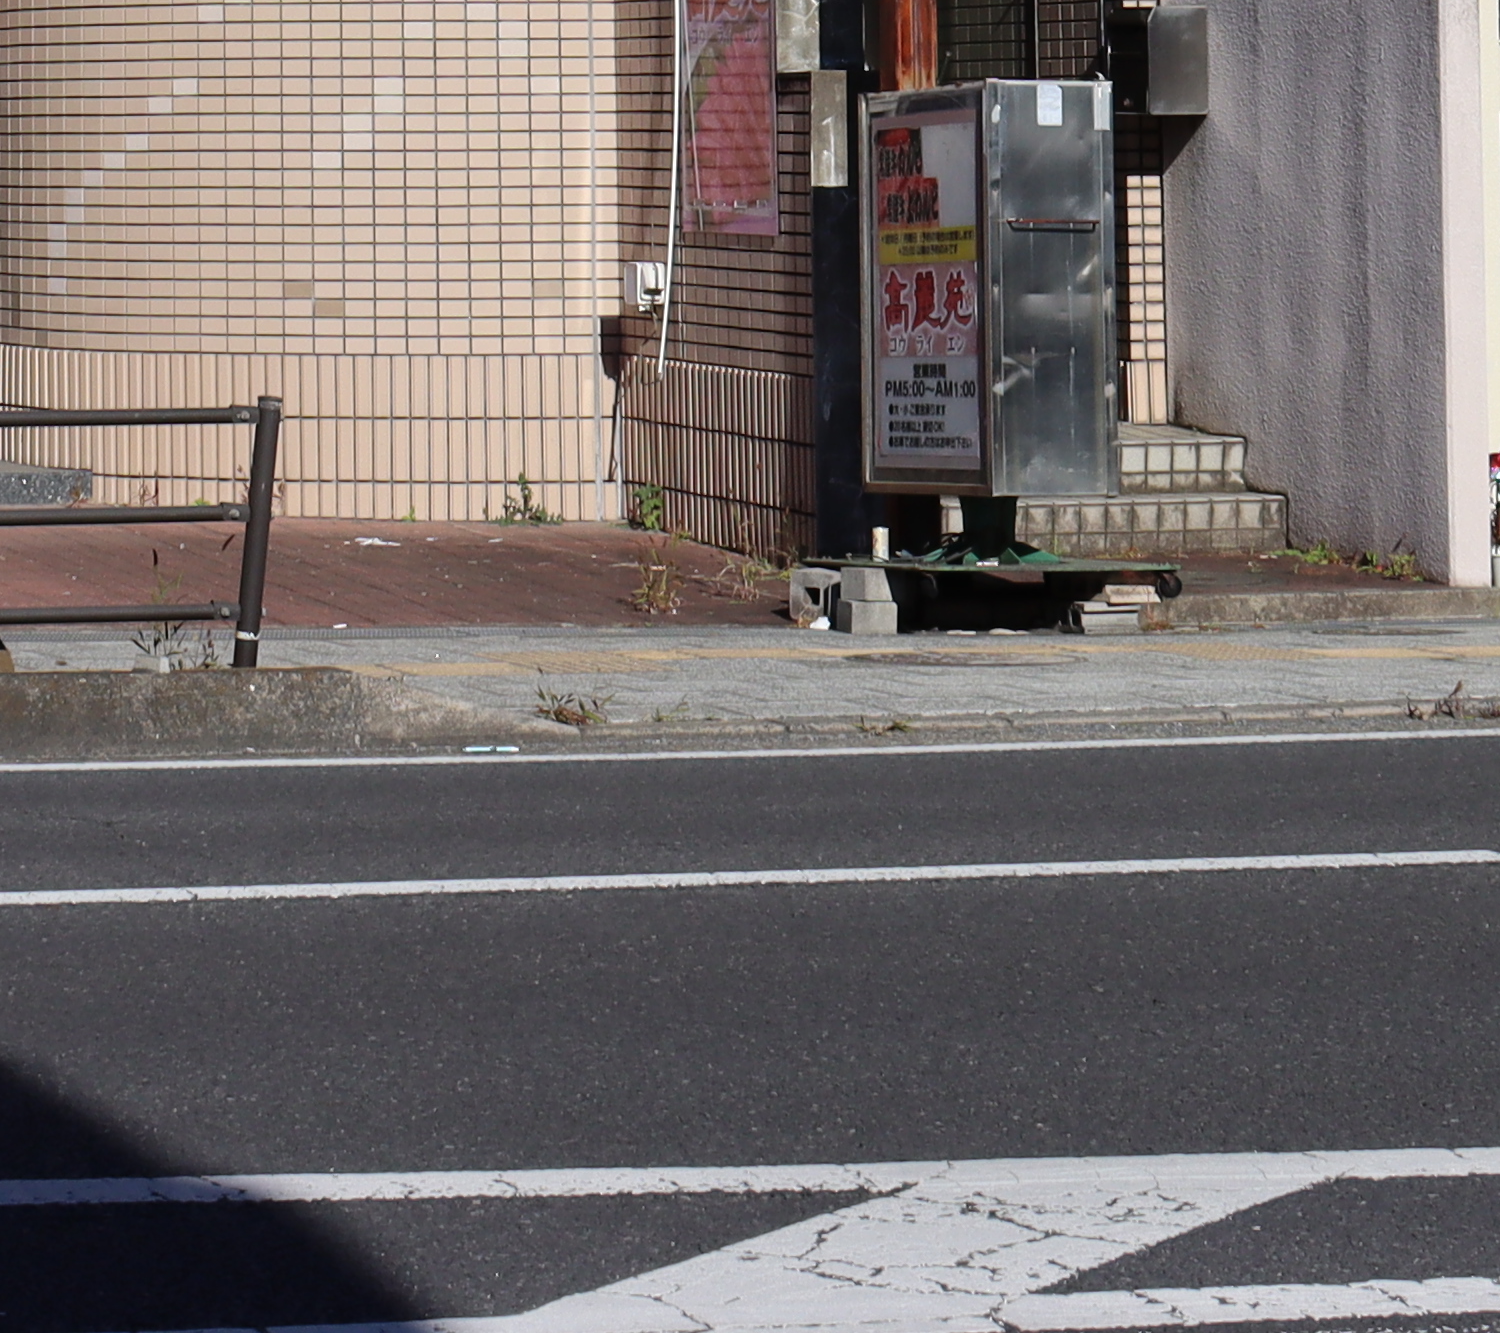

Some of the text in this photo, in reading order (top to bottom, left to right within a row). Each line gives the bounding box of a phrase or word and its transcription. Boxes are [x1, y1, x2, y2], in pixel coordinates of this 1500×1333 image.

[889, 336, 965, 354] コウ ライ エン
